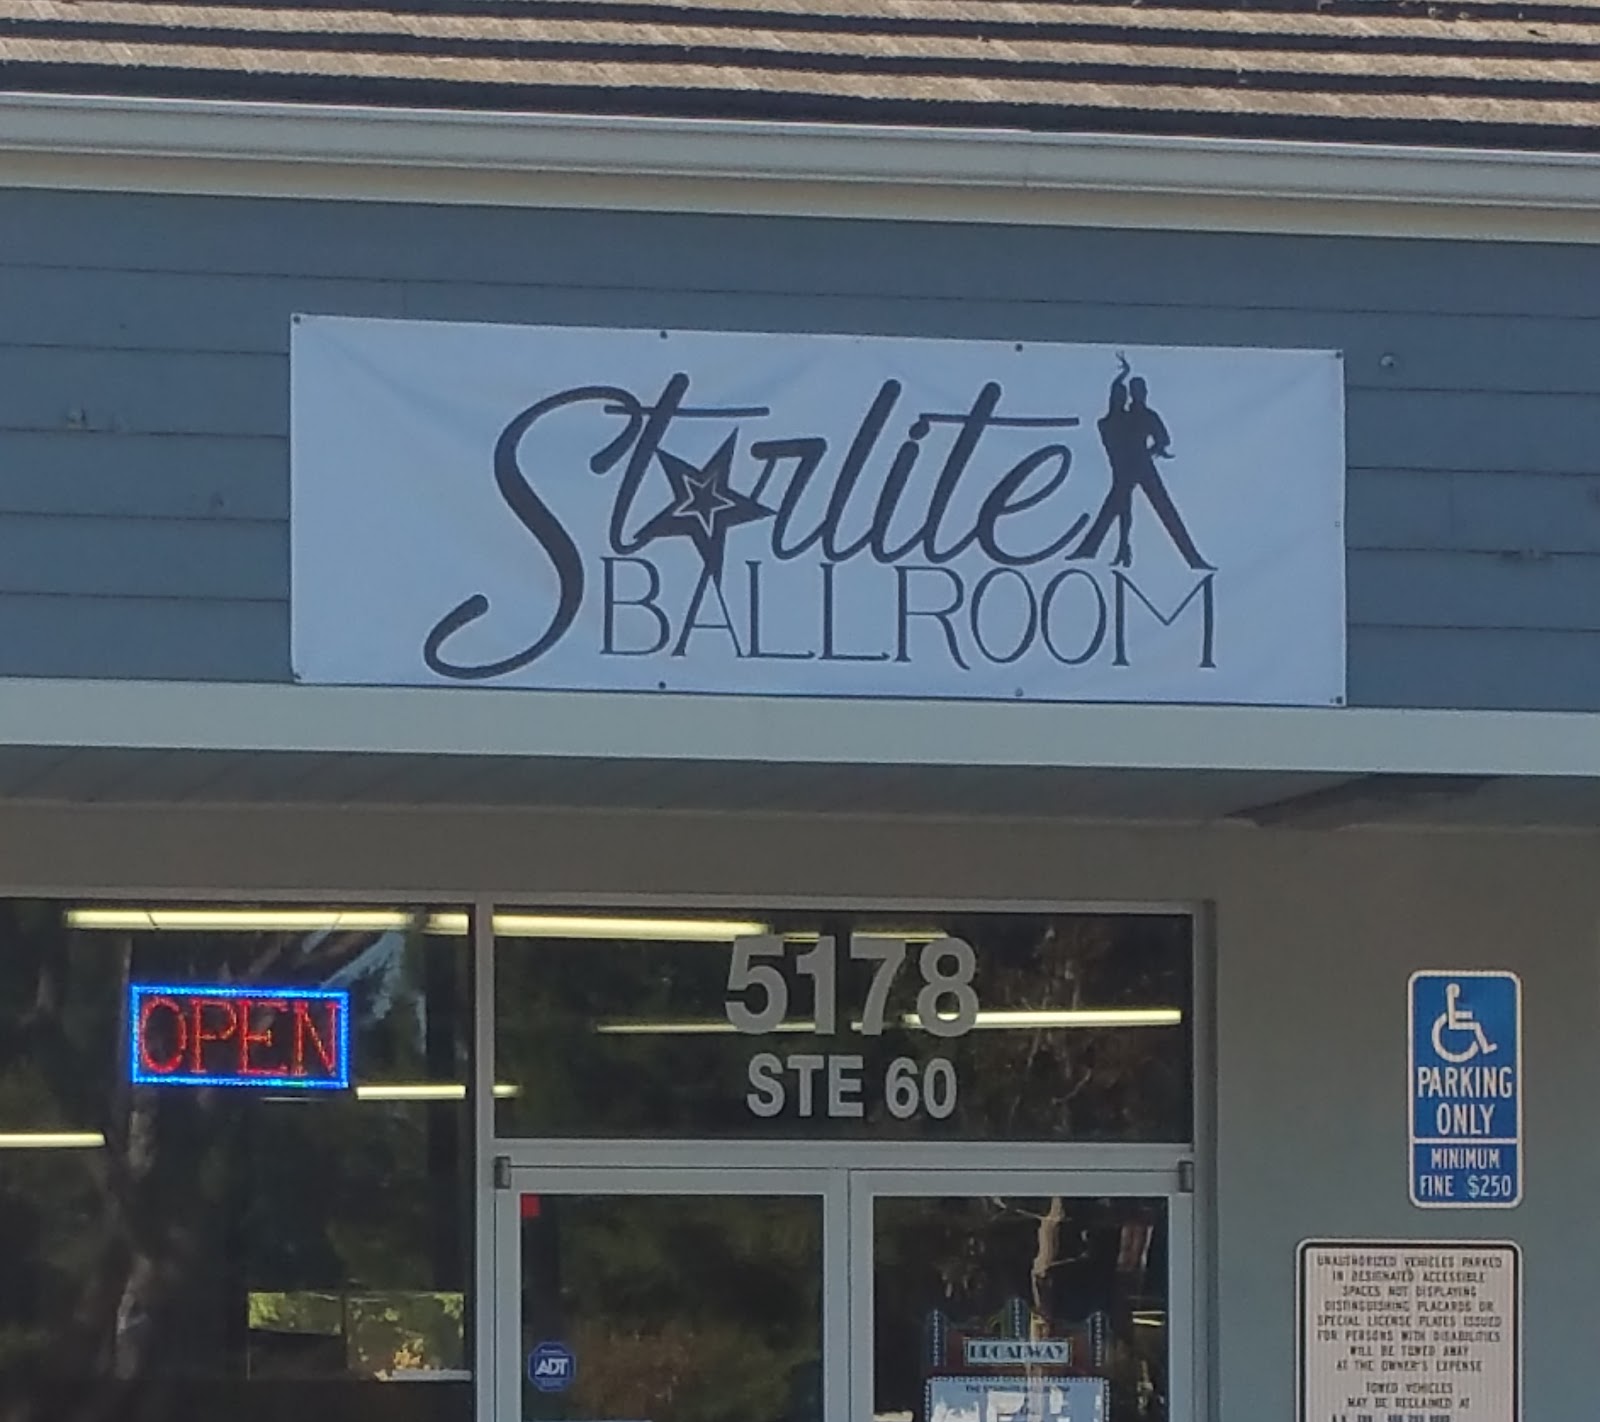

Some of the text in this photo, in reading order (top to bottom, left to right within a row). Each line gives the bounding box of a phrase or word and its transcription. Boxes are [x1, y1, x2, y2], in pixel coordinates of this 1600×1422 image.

[598, 555, 1217, 671] BALLROOM
[725, 934, 979, 1037] 5178
[139, 997, 342, 1077] OPEN
[747, 1053, 957, 1118] STE 60
[1417, 1066, 1513, 1099] PARKING
[1436, 1103, 1495, 1135] ONLY
[1431, 1148, 1500, 1169] MINIMUM
[1420, 1175, 1512, 1198] FINE $250
[1404, 1256, 1455, 1268] VEHICLES
[1462, 1256, 1503, 1268] PARKED
[1333, 1270, 1486, 1283] IN DESIGNATED ACCESSIBLE
[1343, 1285, 1477, 1297] SPACES NOT DISPLAYING
[1417, 1300, 1472, 1312] PLACARDS
[1479, 1301, 1494, 1312] OR
[1317, 1315, 1502, 1327] SPECIAL LICENSE PLATES ISSUED
[1317, 1330, 1501, 1342] FOR PERSONS WITH DISABILITIES
[1350, 1345, 1468, 1357] WILL BE TOWED AWAY
[535, 1357, 569, 1376] ADT
[1337, 1360, 1483, 1372] AT THE OWNER'S EXPENSE
[1366, 1382, 1453, 1394] TOWED VEHICLES
[1348, 1397, 1470, 1409] MAY BE RECLAIMED AT
